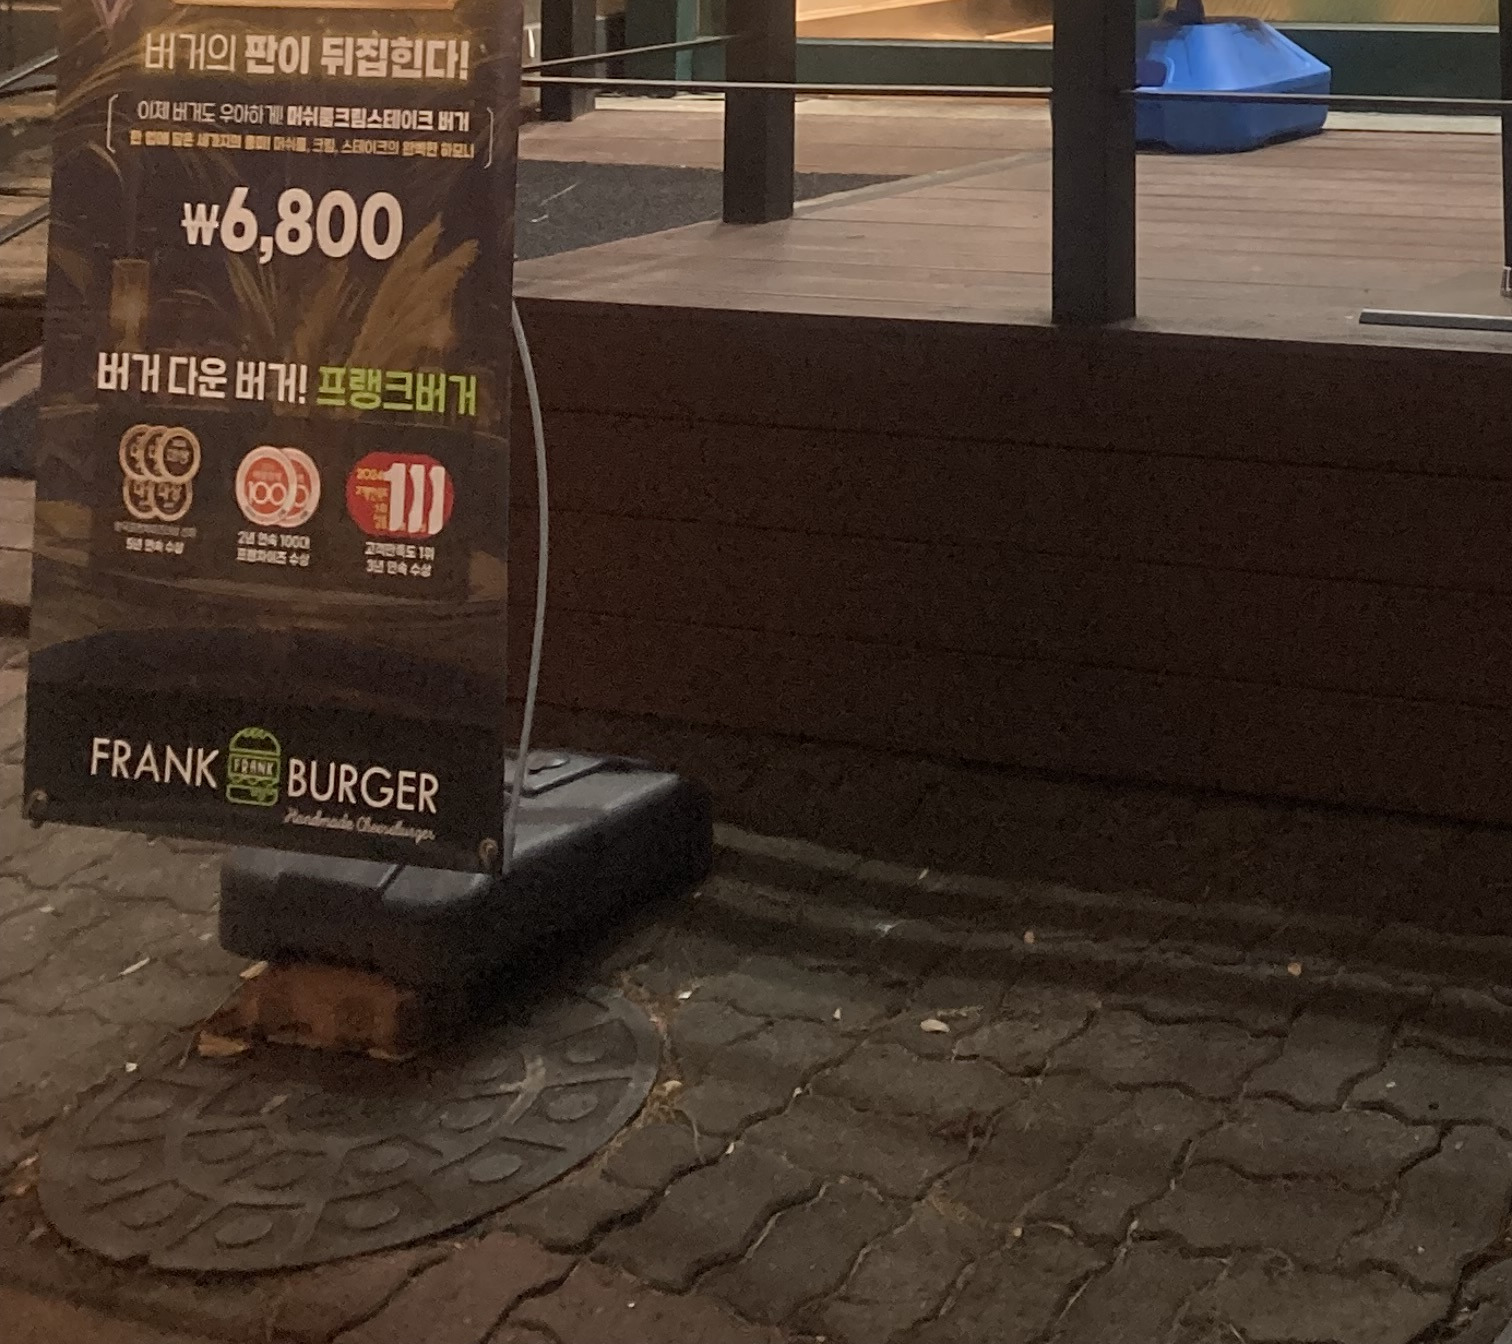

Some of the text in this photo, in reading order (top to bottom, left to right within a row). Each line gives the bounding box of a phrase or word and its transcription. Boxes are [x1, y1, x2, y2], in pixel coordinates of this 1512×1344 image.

[144, 32, 469, 81] 버거의 판이 뒤집힌다!
[137, 100, 169, 121] 이제
[172, 101, 216, 123] 버거도
[287, 105, 433, 131] 머쉬룸크림스테이크
[438, 111, 470, 132] 버거
[97, 351, 477, 417] 버거 다운 버거! 프랭크버거
[90, 737, 219, 789] FRANK
[288, 759, 439, 813] BURGER
